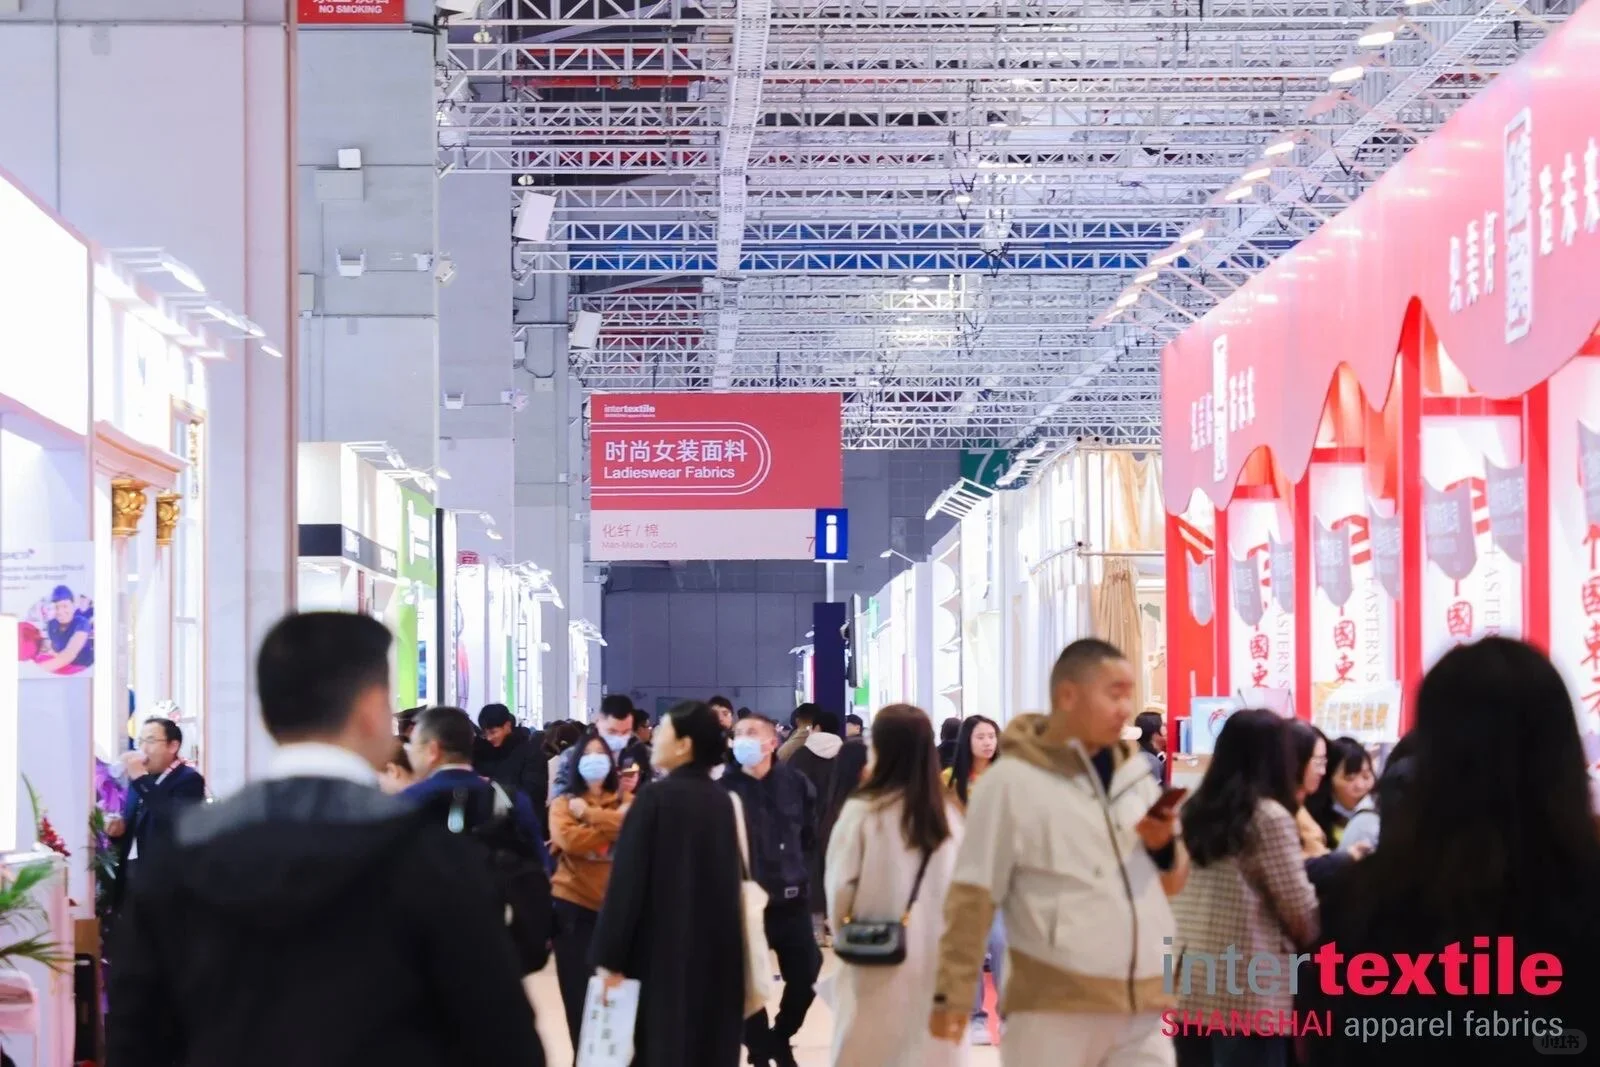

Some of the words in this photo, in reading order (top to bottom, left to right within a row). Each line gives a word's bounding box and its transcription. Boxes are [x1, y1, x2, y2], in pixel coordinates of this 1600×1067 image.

[319, 5, 334, 13] NO
[336, 5, 382, 13] SMOKING
[605, 439, 748, 462] 时尚女装面料
[604, 467, 682, 479] Ladieswear
[685, 466, 735, 479] Fabrics
[602, 524, 632, 537] 化纤
[645, 524, 659, 537] 棉
